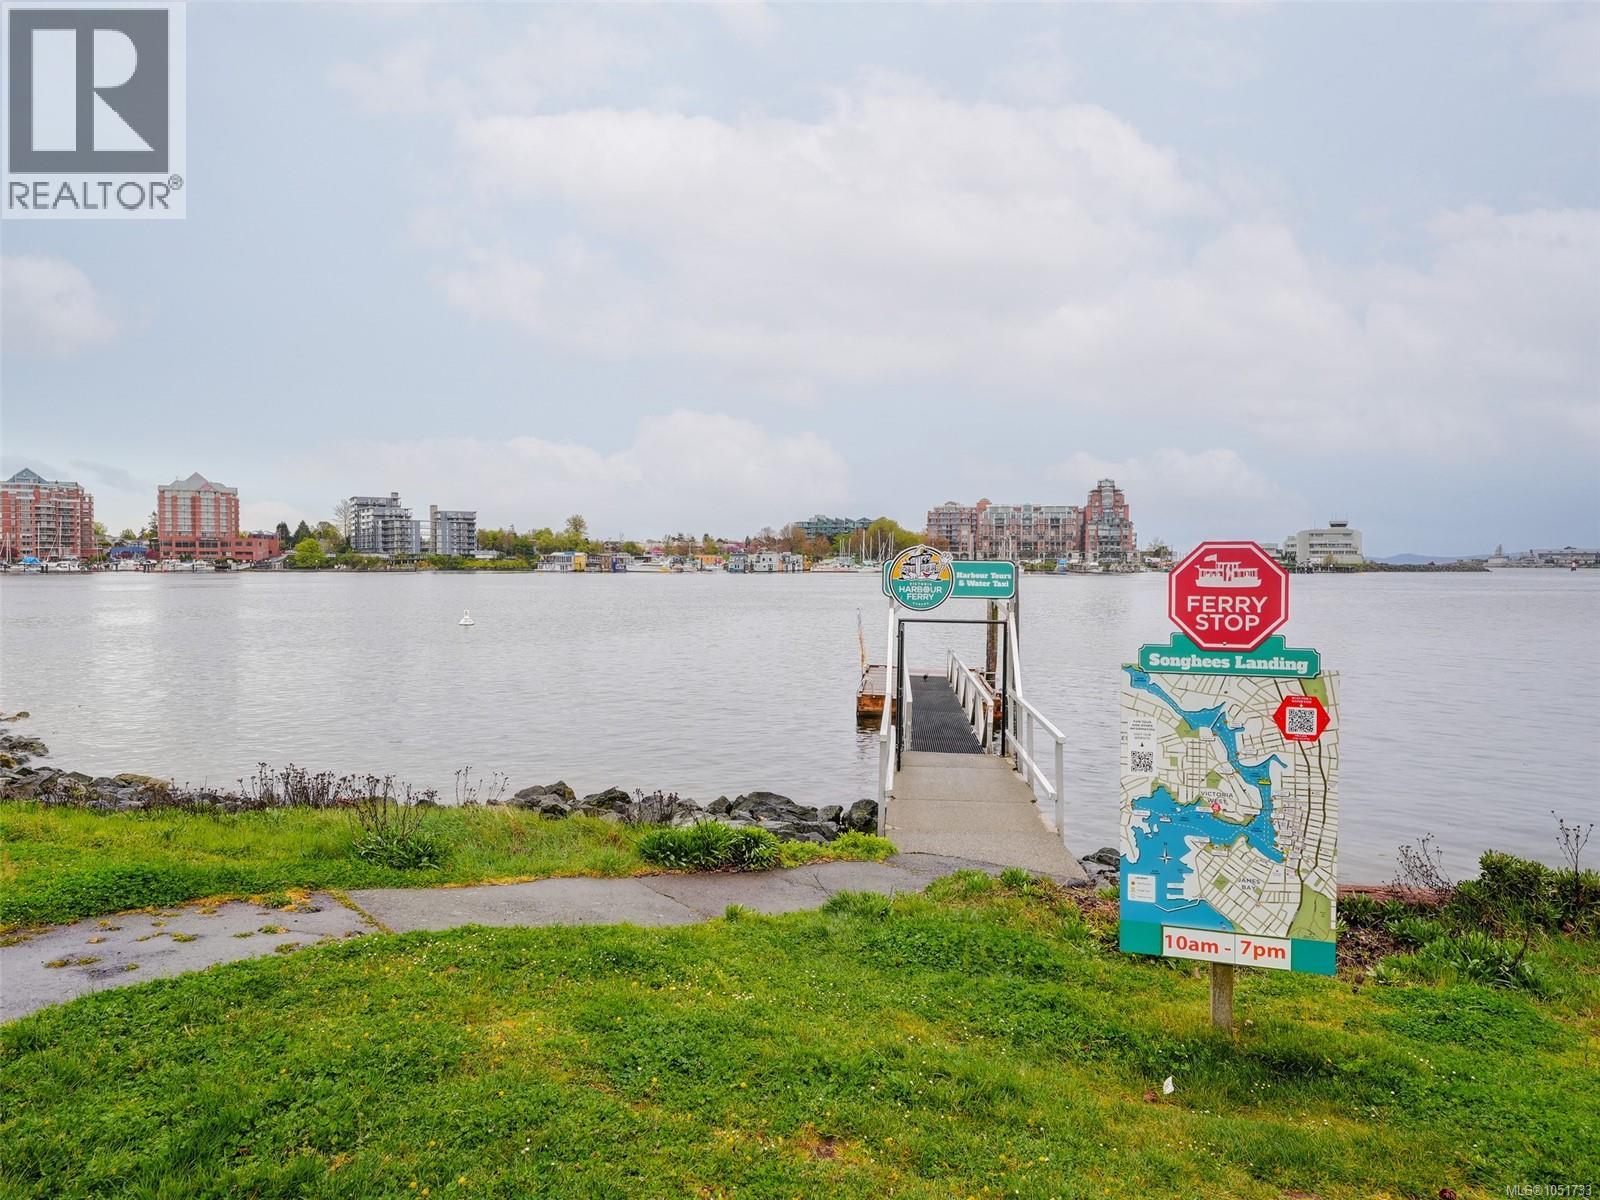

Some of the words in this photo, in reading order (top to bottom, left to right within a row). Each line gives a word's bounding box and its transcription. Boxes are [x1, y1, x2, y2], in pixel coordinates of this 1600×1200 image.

[956, 571, 989, 580] Harbour
[990, 572, 1012, 580] Tours
[898, 585, 943, 594] HARBOUR
[966, 580, 991, 588] Water
[906, 593, 935, 601] FERRY
[1186, 595, 1268, 613] FERRY
[1195, 614, 1260, 632] STOP
[1149, 653, 1231, 670] Songhees
[1234, 655, 1309, 673] Landing
[1165, 934, 1219, 954] 10am
[1240, 940, 1287, 960] 7pm
